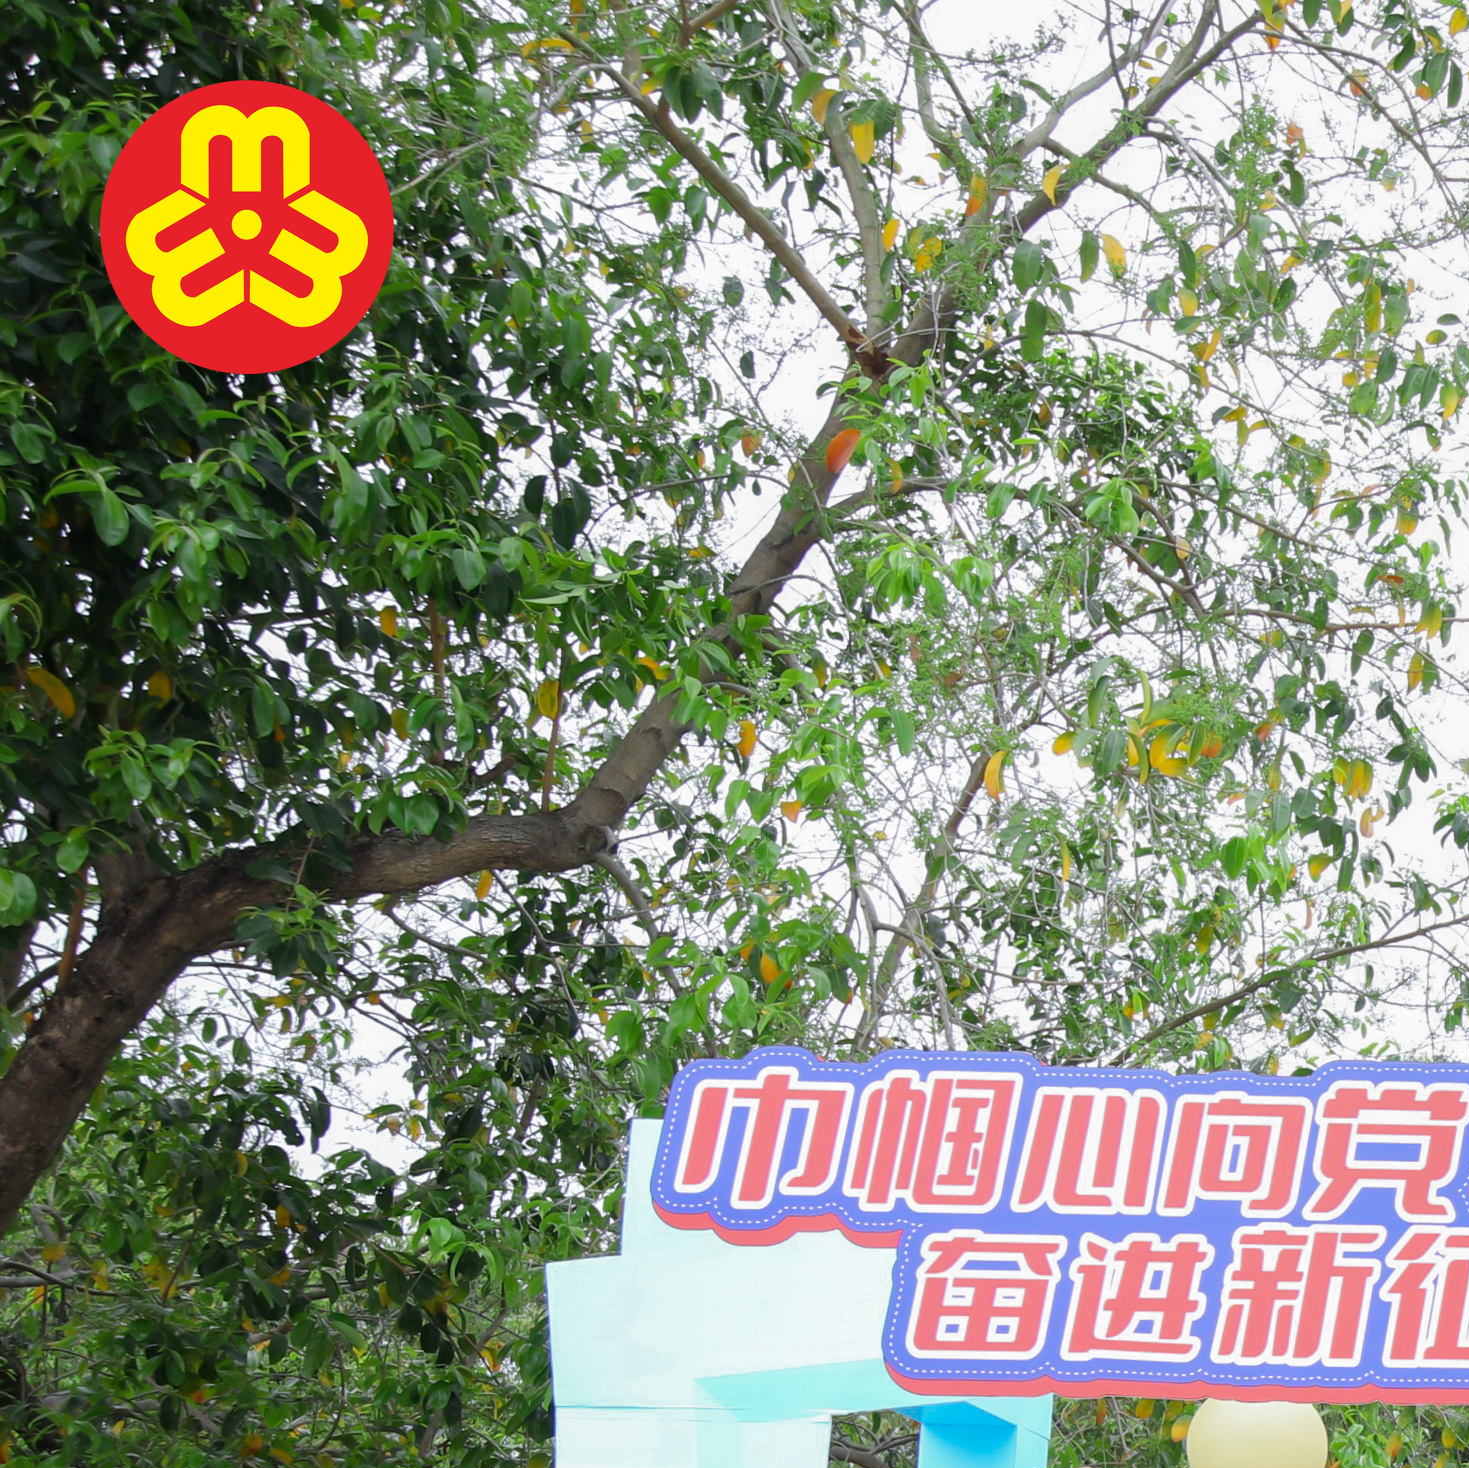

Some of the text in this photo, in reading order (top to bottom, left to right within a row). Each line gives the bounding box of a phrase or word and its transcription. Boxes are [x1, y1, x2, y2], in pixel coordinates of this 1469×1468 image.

[672, 1072, 1469, 1218] 巾帼心向党
